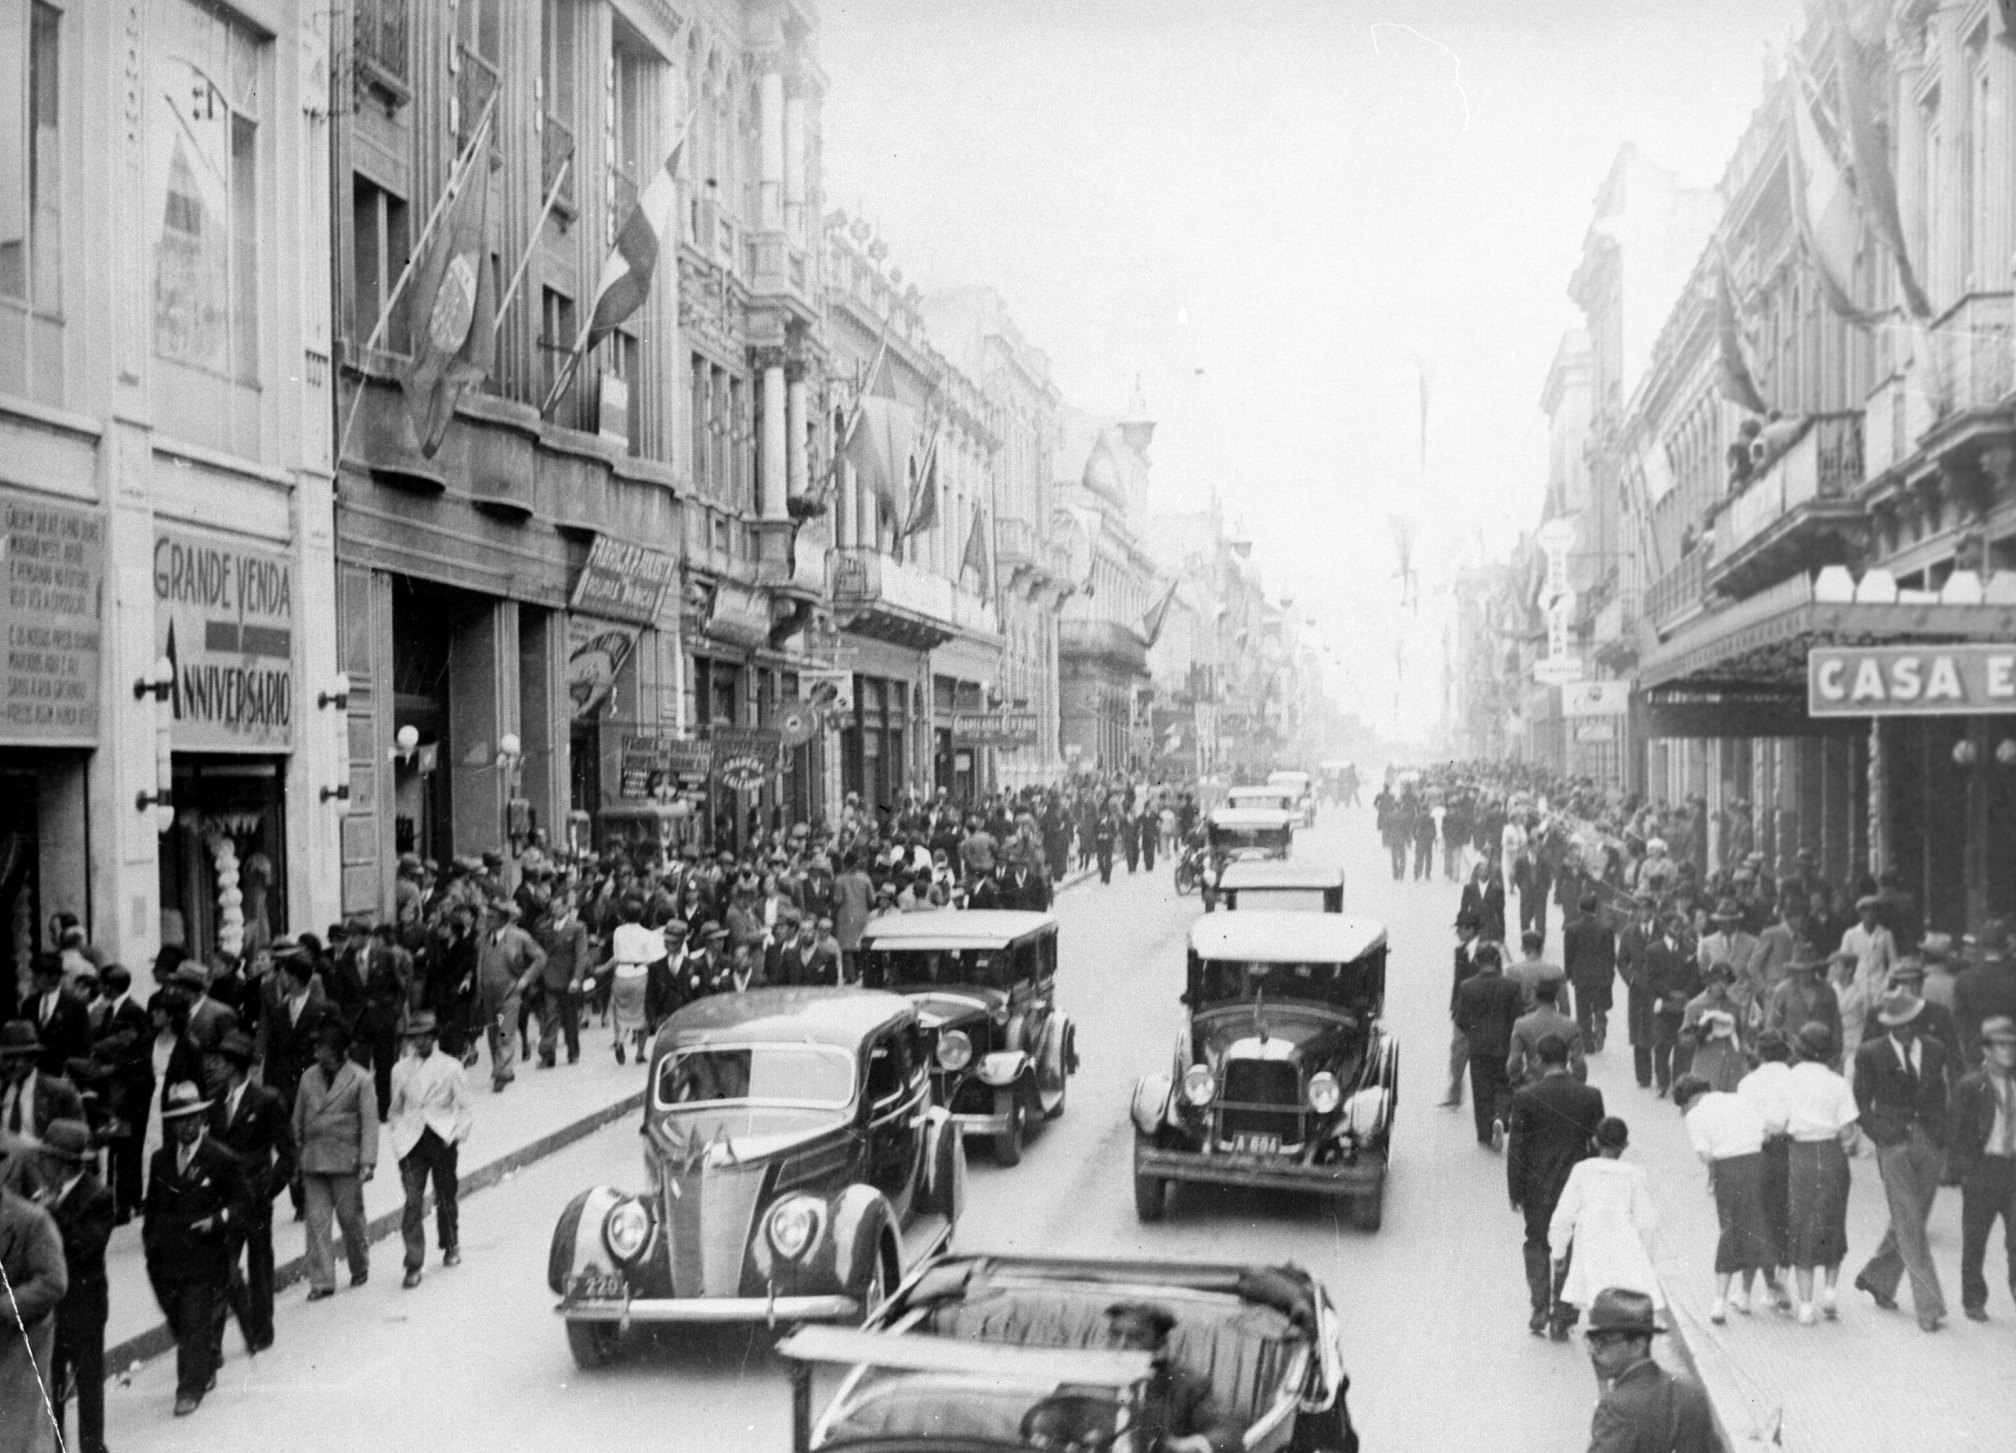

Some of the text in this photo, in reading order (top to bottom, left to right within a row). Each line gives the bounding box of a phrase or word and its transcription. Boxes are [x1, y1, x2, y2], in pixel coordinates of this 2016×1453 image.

[154, 537, 291, 640] GRANDE VENDA
[166, 616, 291, 726] ANNIVERSARIO
[1818, 656, 2015, 700] CASA E
